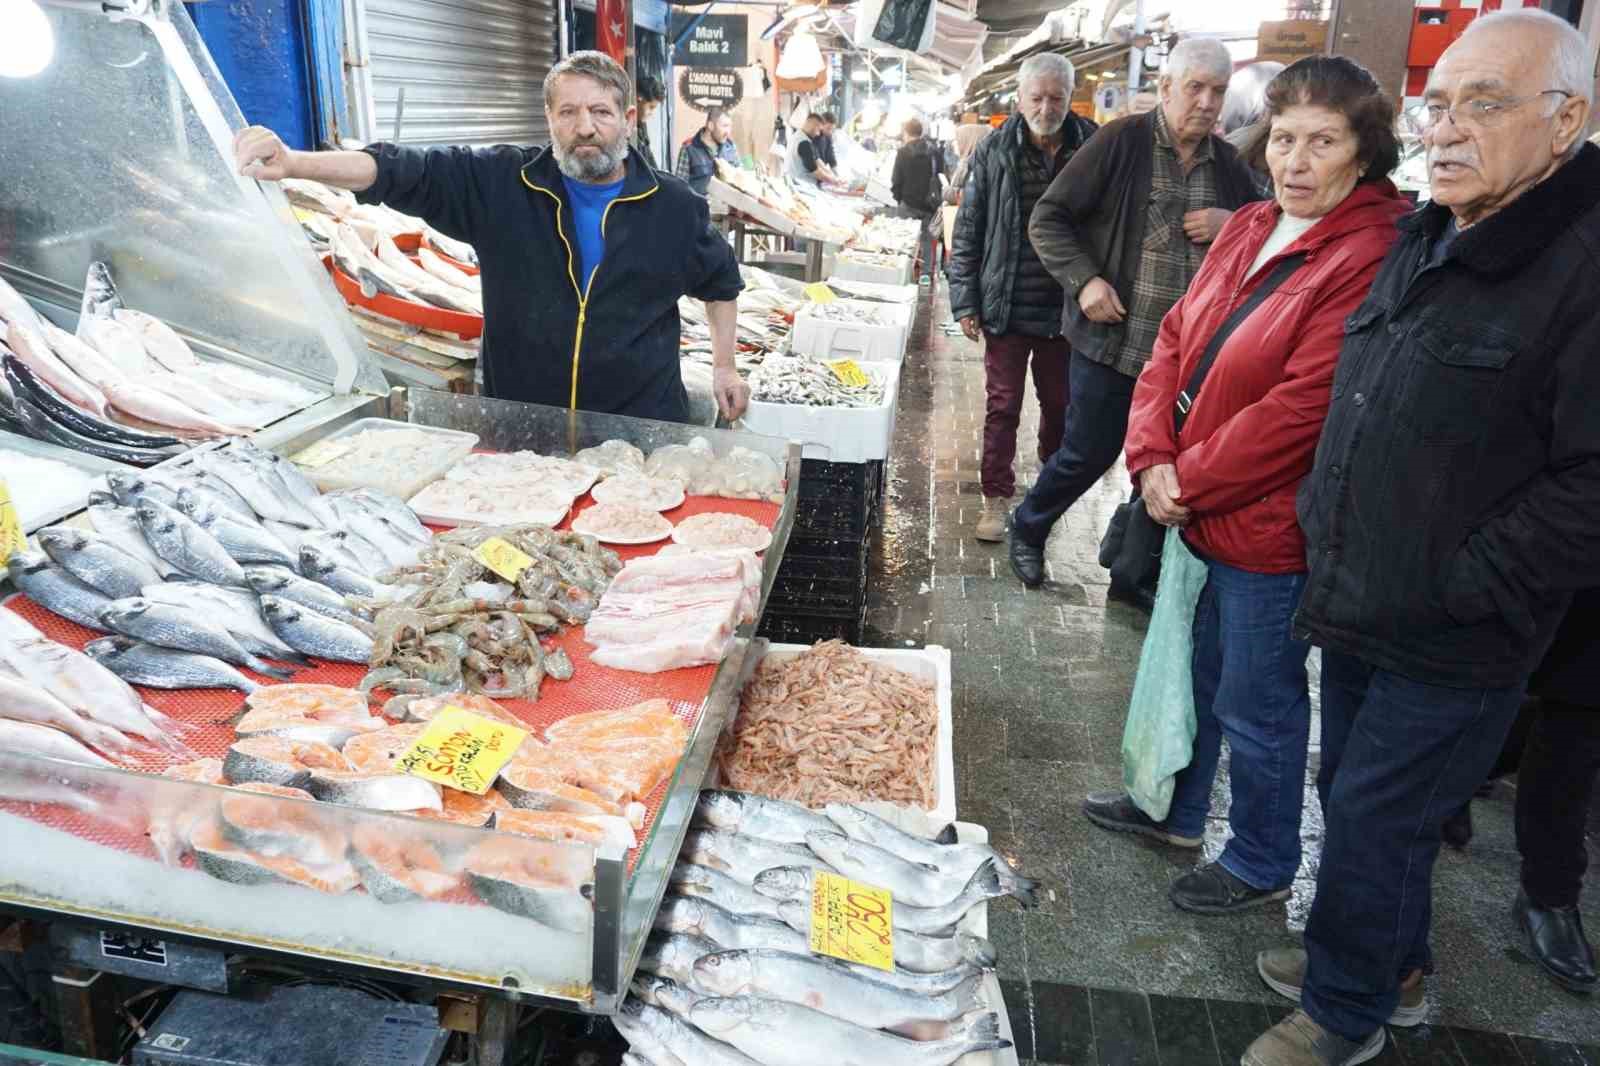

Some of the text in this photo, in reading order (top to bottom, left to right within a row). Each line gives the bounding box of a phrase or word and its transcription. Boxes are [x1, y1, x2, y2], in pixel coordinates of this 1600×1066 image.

[695, 26, 724, 39] Mavi
[689, 40, 730, 53] Balık 2
[688, 72, 735, 86] L'AGORA OLD
[688, 84, 734, 97] TOWN HOTEL
[426, 731, 471, 776] SOMON
[845, 893, 890, 945] 250
